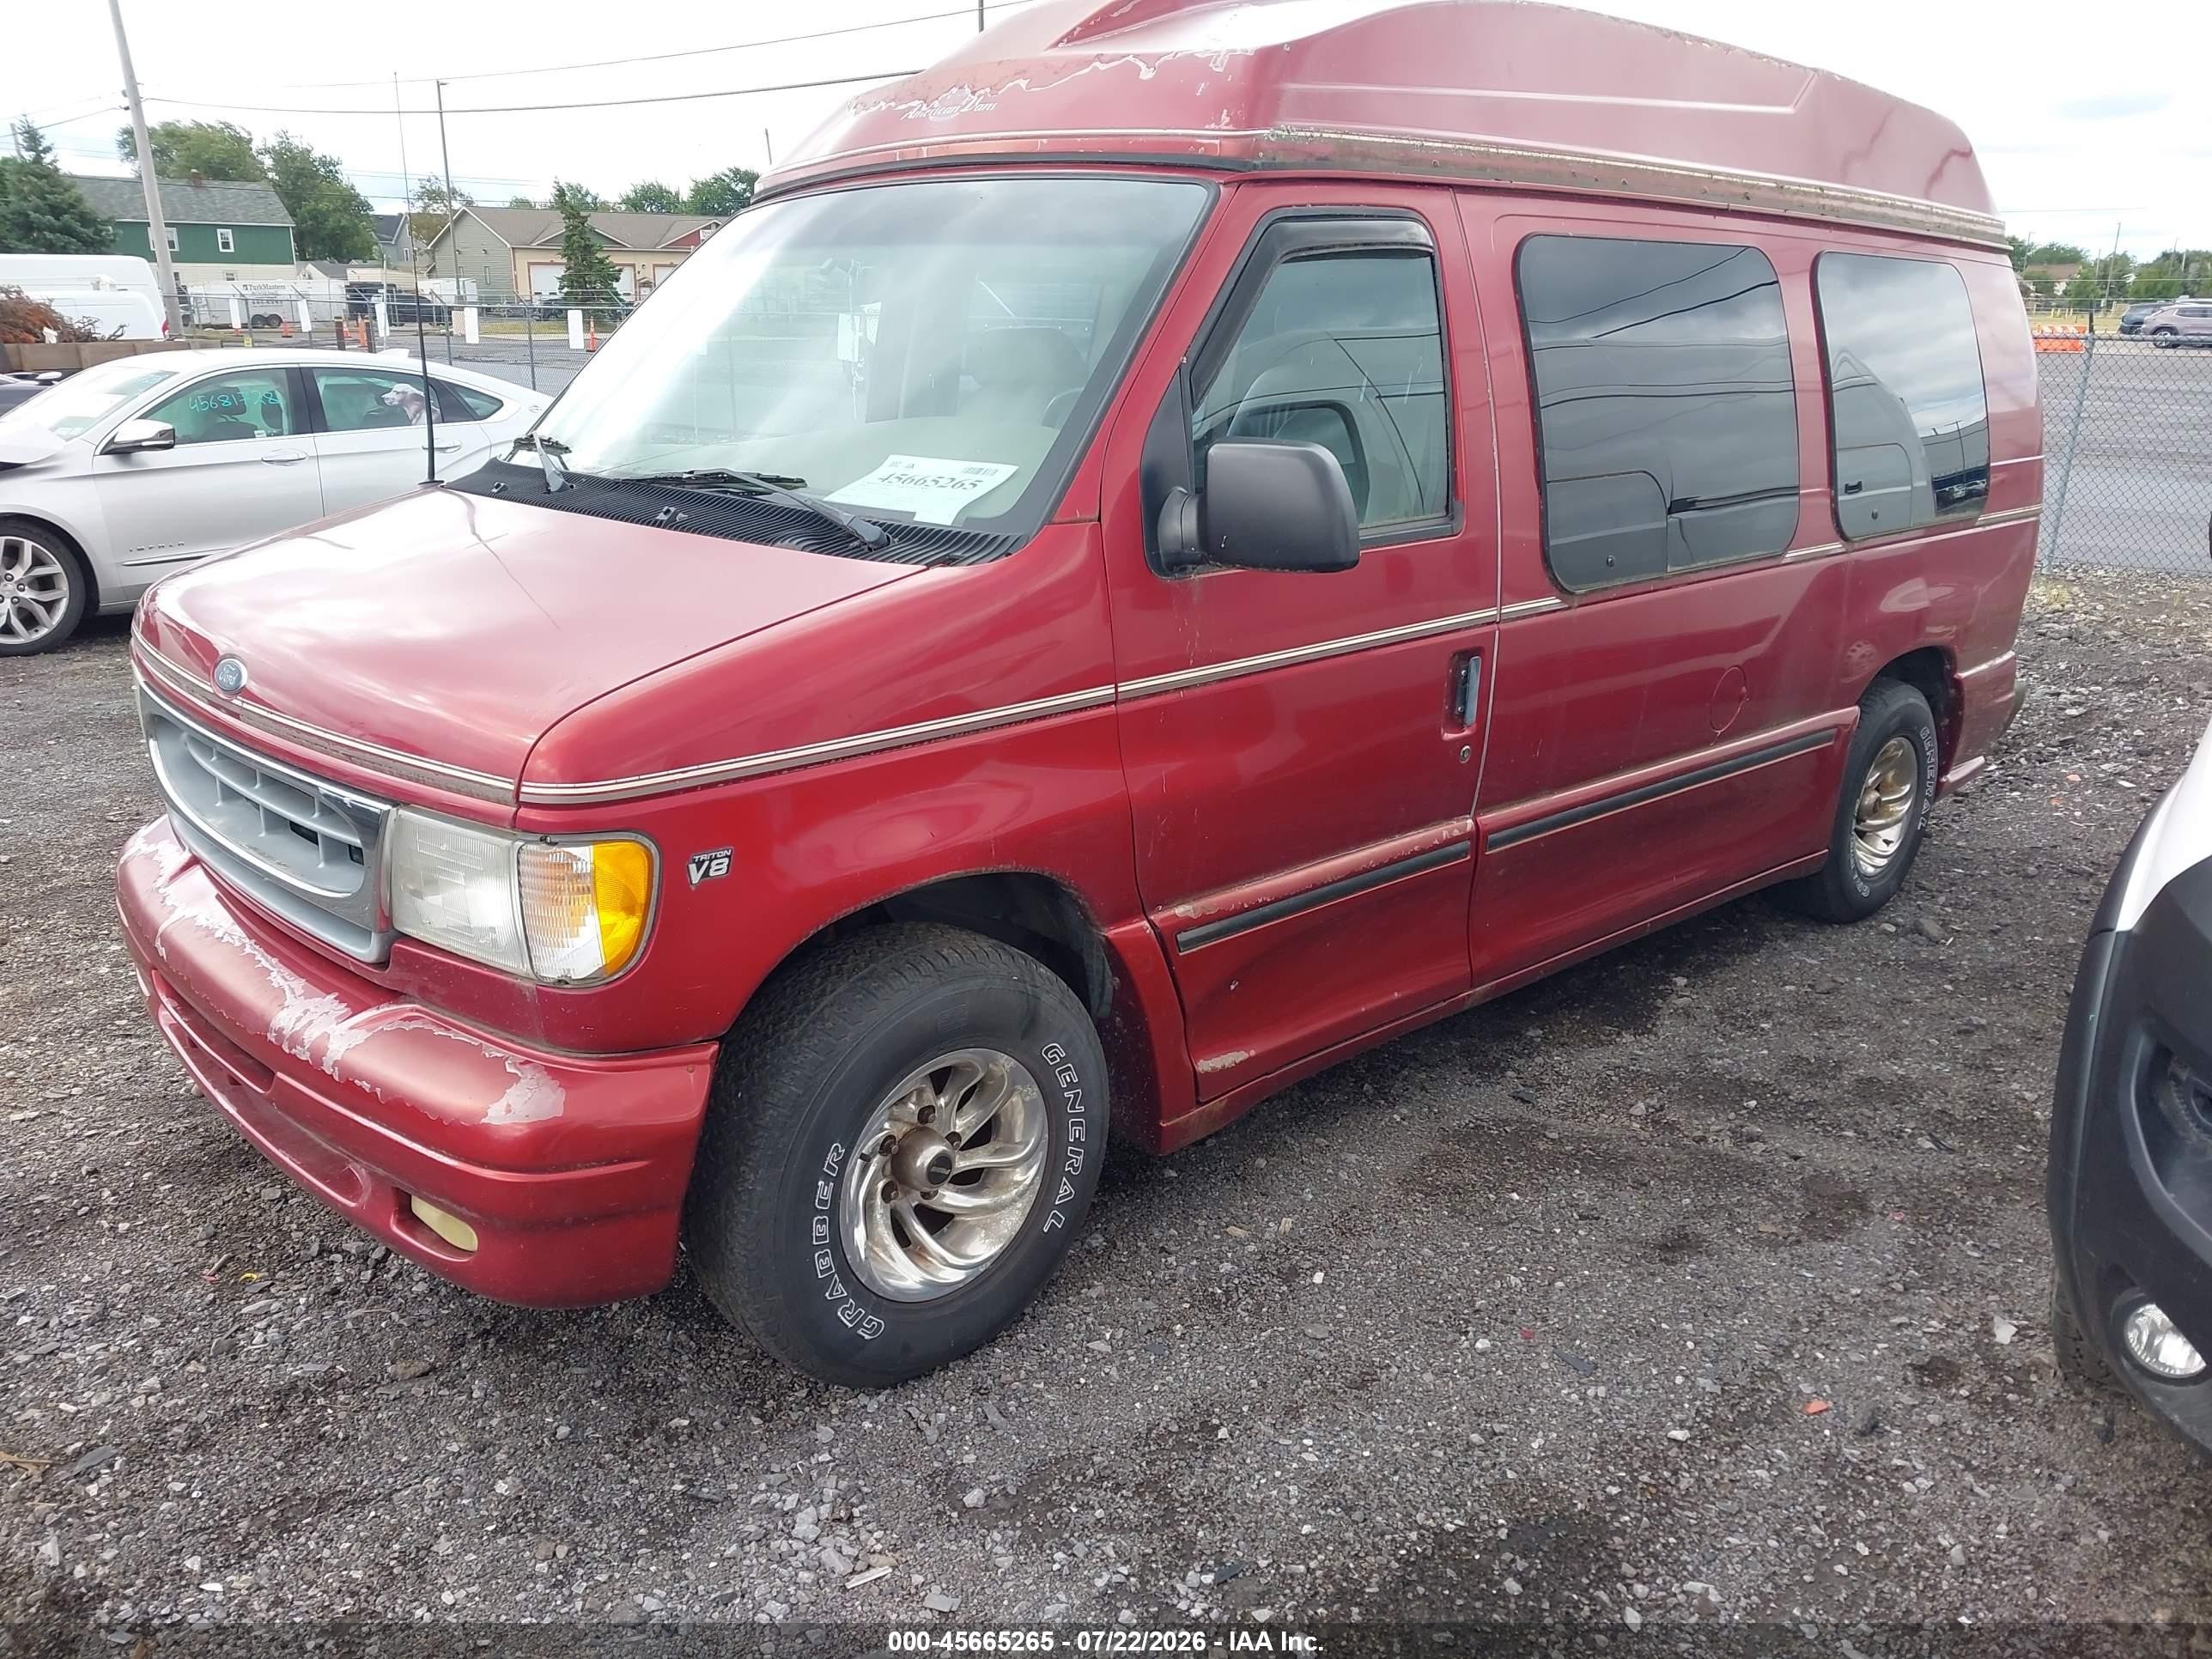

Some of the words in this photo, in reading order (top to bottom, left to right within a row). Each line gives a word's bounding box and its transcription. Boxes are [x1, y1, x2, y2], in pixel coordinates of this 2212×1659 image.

[900, 98, 961, 119] American
[961, 93, 998, 112] Vans
[877, 471, 984, 490] 45665265
[1917, 726, 1936, 830] GENERAL
[693, 848, 732, 863] TRITON
[688, 857, 730, 884] V8
[1041, 1042, 1086, 1233] GENERAL
[812, 1142, 885, 1340] GRABBER
